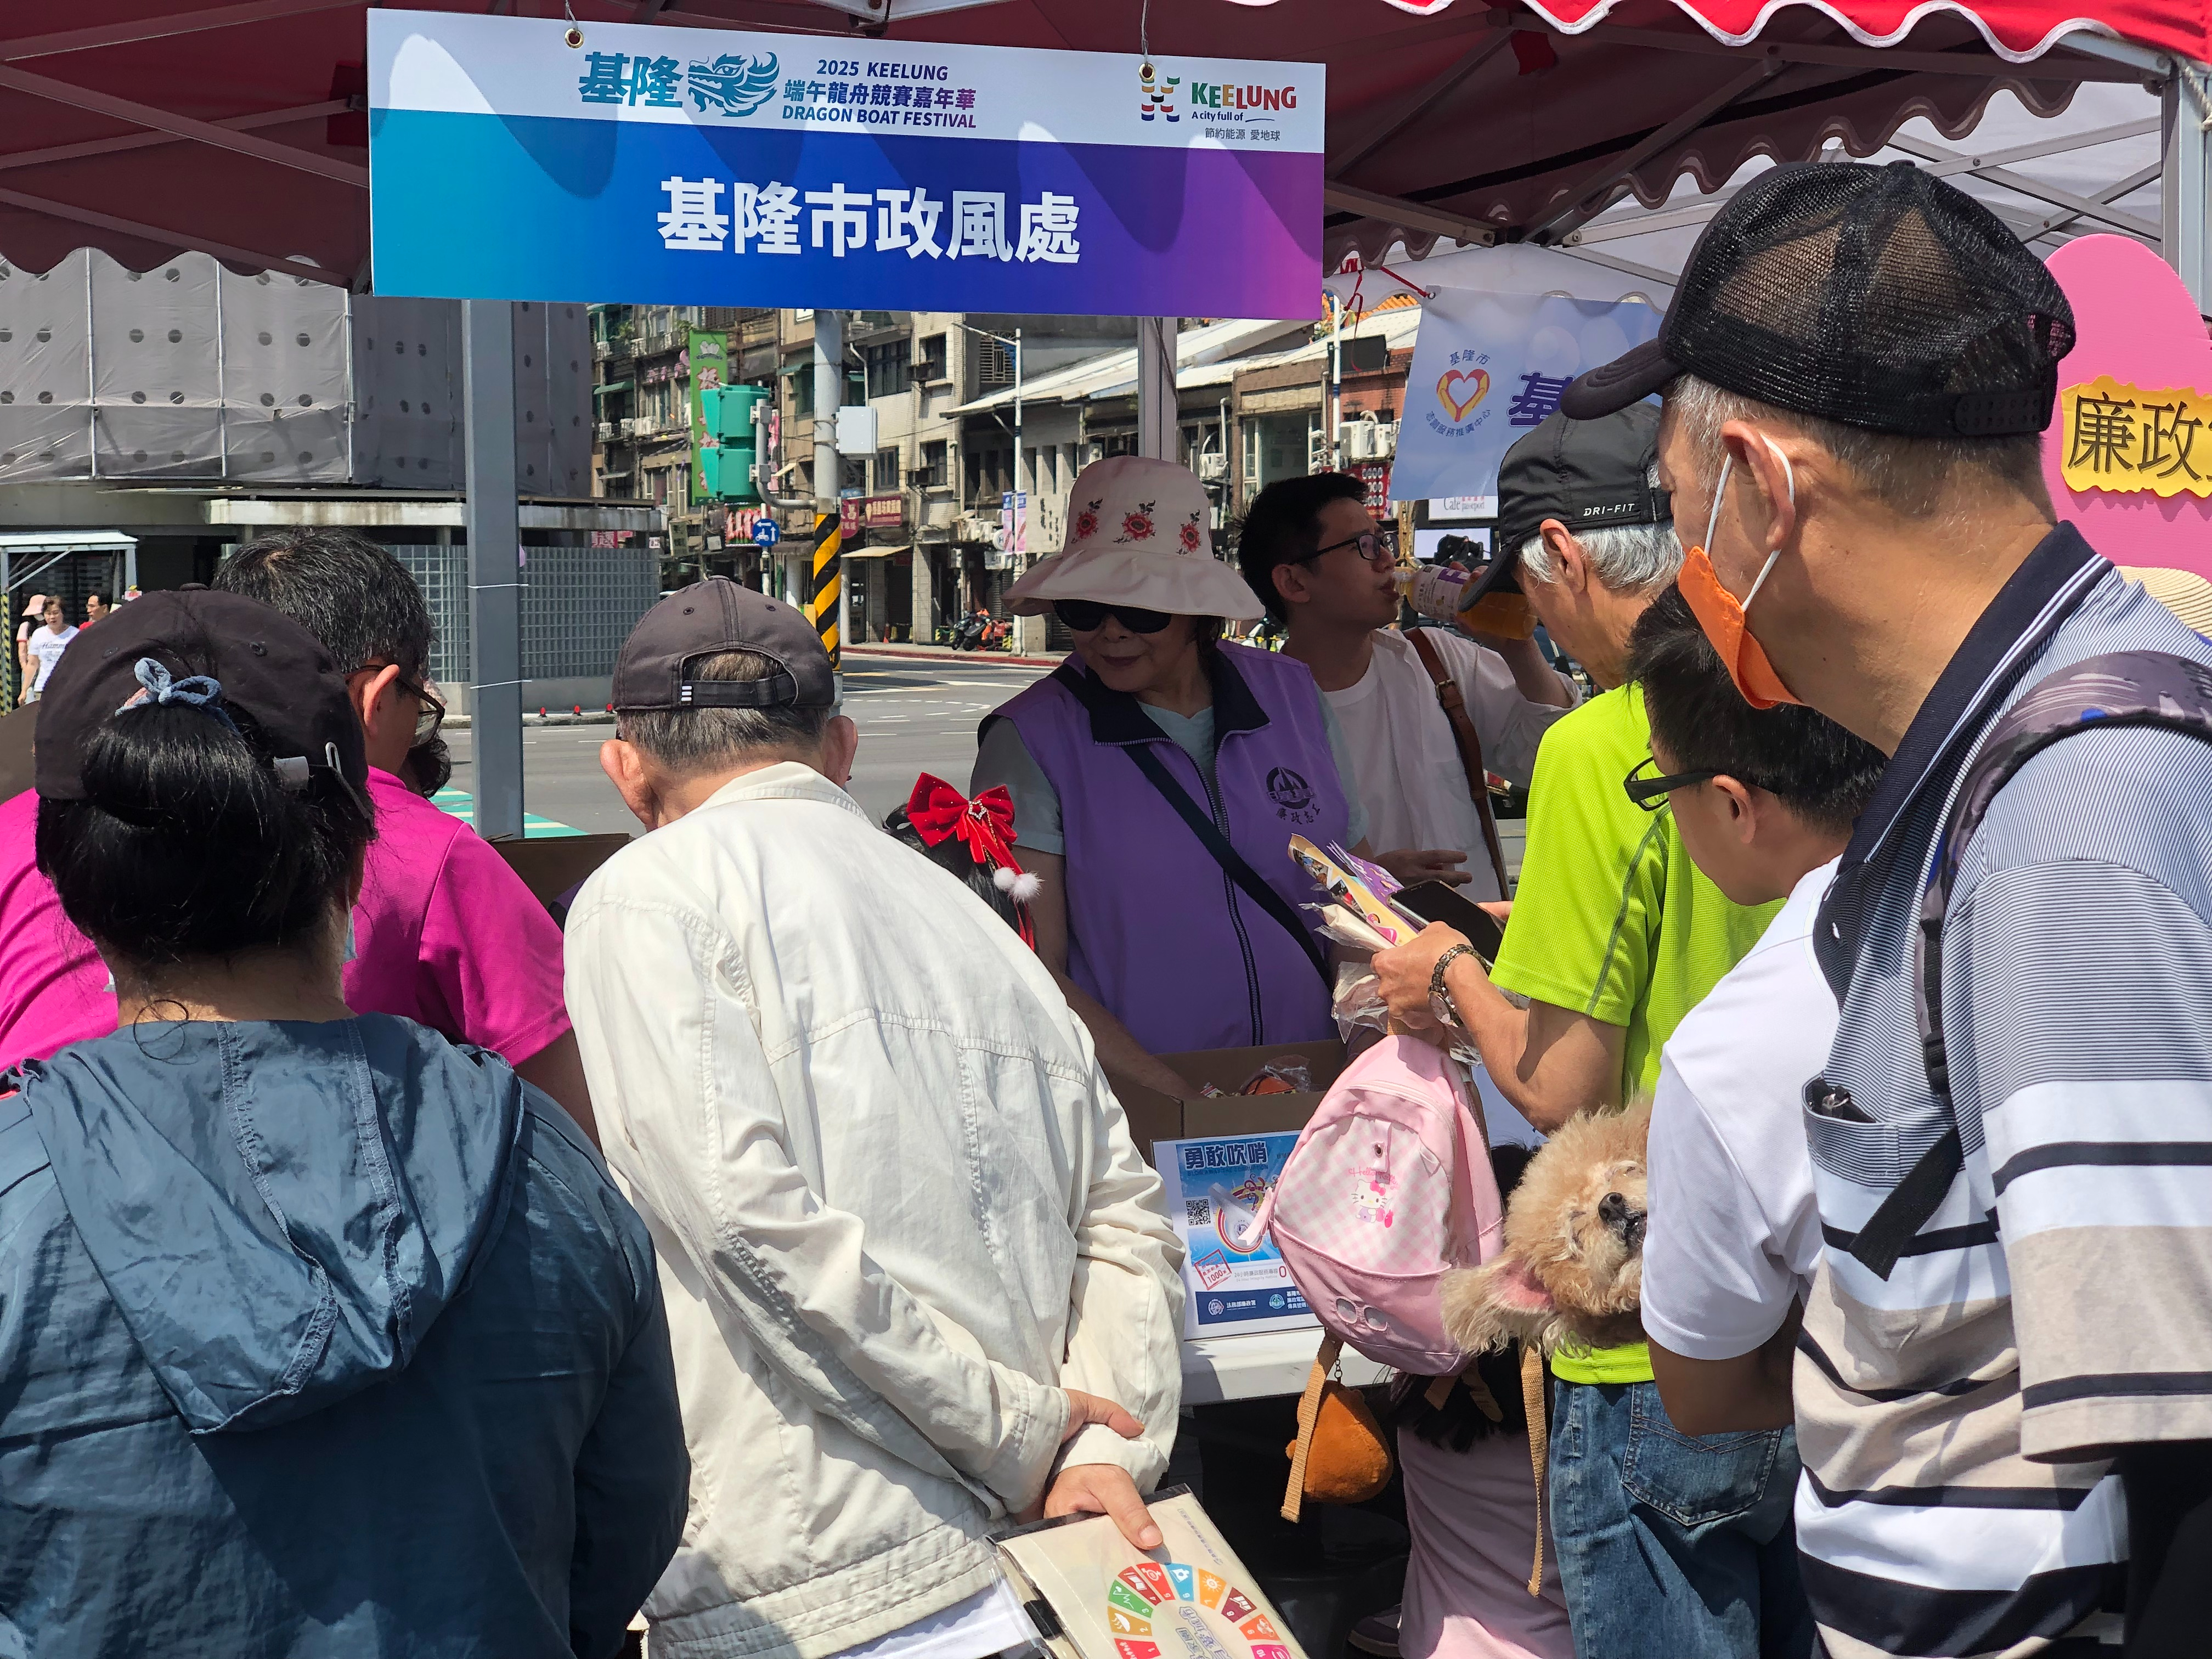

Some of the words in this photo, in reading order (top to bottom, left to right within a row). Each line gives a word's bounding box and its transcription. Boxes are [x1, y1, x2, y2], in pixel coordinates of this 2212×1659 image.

[578, 52, 684, 108] 基隆
[816, 59, 859, 76] 2025
[867, 62, 948, 81] KEELUNG
[783, 80, 976, 110] 端午龍舟競賽嘉年華
[1192, 82, 1296, 111] KEELUNG
[782, 105, 852, 122] DRAGON
[857, 109, 900, 125] BOAT
[904, 111, 977, 128] FESTIVAL
[1192, 111, 1199, 120] A
[1200, 111, 1216, 122] city
[1217, 112, 1232, 121] full
[1234, 112, 1244, 121] of
[1205, 127, 1246, 140] 節約能源
[1250, 129, 1280, 141] 愛地球
[657, 176, 1080, 263] 基隆市政風處
[1449, 349, 1491, 366] 基隆市
[1508, 371, 1575, 427] 基
[2068, 391, 2212, 481] 廉政
[1583, 503, 1635, 516] DRI-FIT
[1184, 1142, 1267, 1170] 勇敢吹哨
[1256, 1649, 1266, 1658] 10
